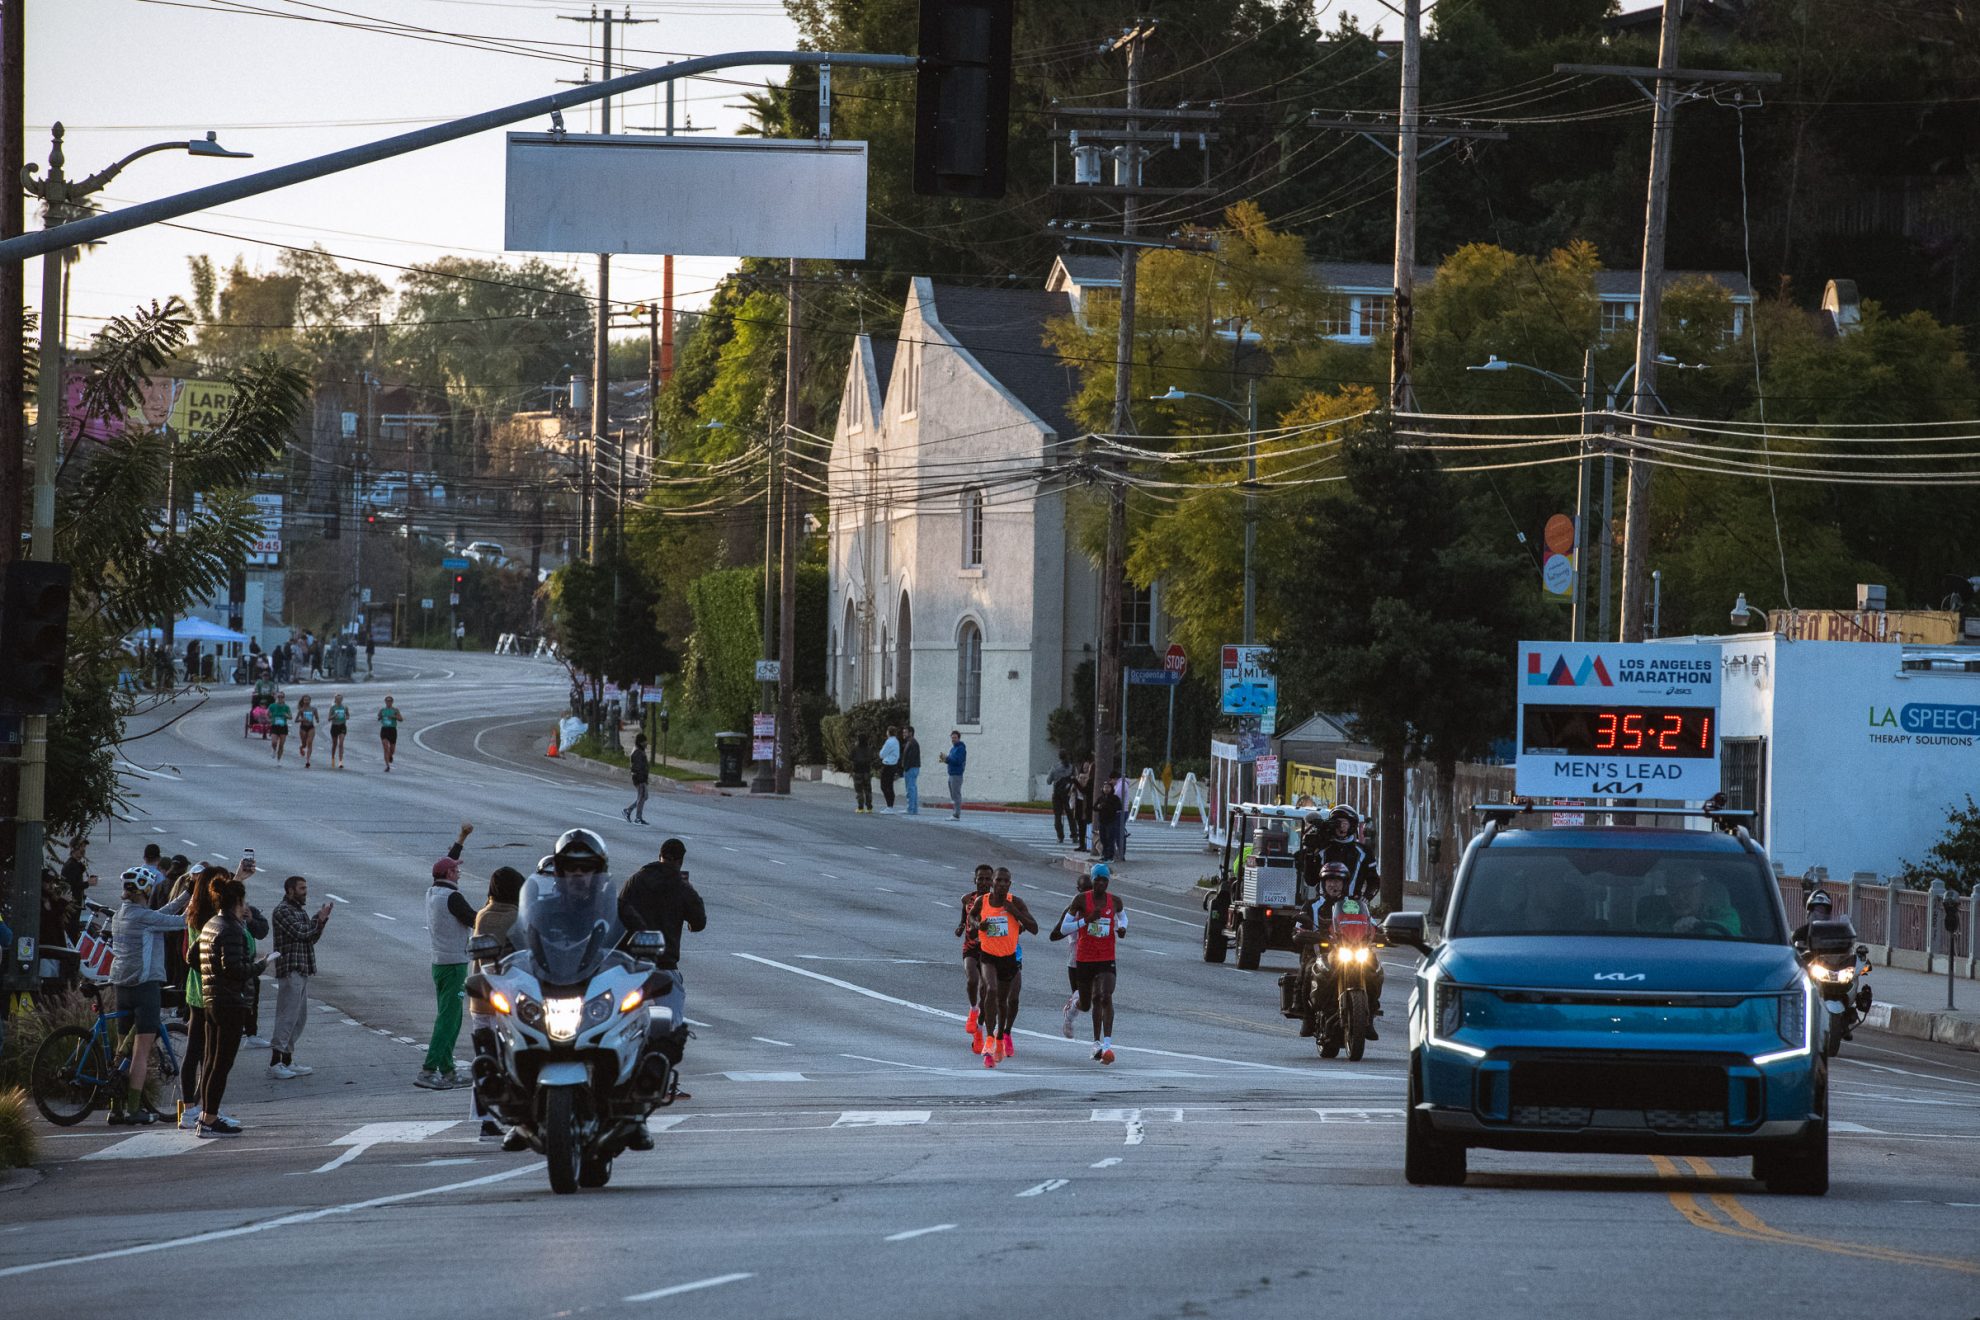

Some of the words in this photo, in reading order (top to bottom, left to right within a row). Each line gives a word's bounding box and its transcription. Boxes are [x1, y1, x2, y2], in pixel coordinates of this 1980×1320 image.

[1776, 613, 1819, 640] ATO
[1166, 655, 1185, 670] STOP
[1620, 659, 1645, 670] LOS
[1650, 659, 1712, 671] ANGELES
[1131, 670, 1166, 679] Occidental
[1231, 668, 1269, 678] LMI
[1619, 670, 1712, 684] MARATHON
[1869, 706, 1898, 727] LA
[1869, 733, 1911, 744] THERAPY
[1915, 735, 1973, 746] SOLUTIONS
[1554, 761, 1619, 779] MEN'S
[1626, 763, 1683, 780] LEAD
